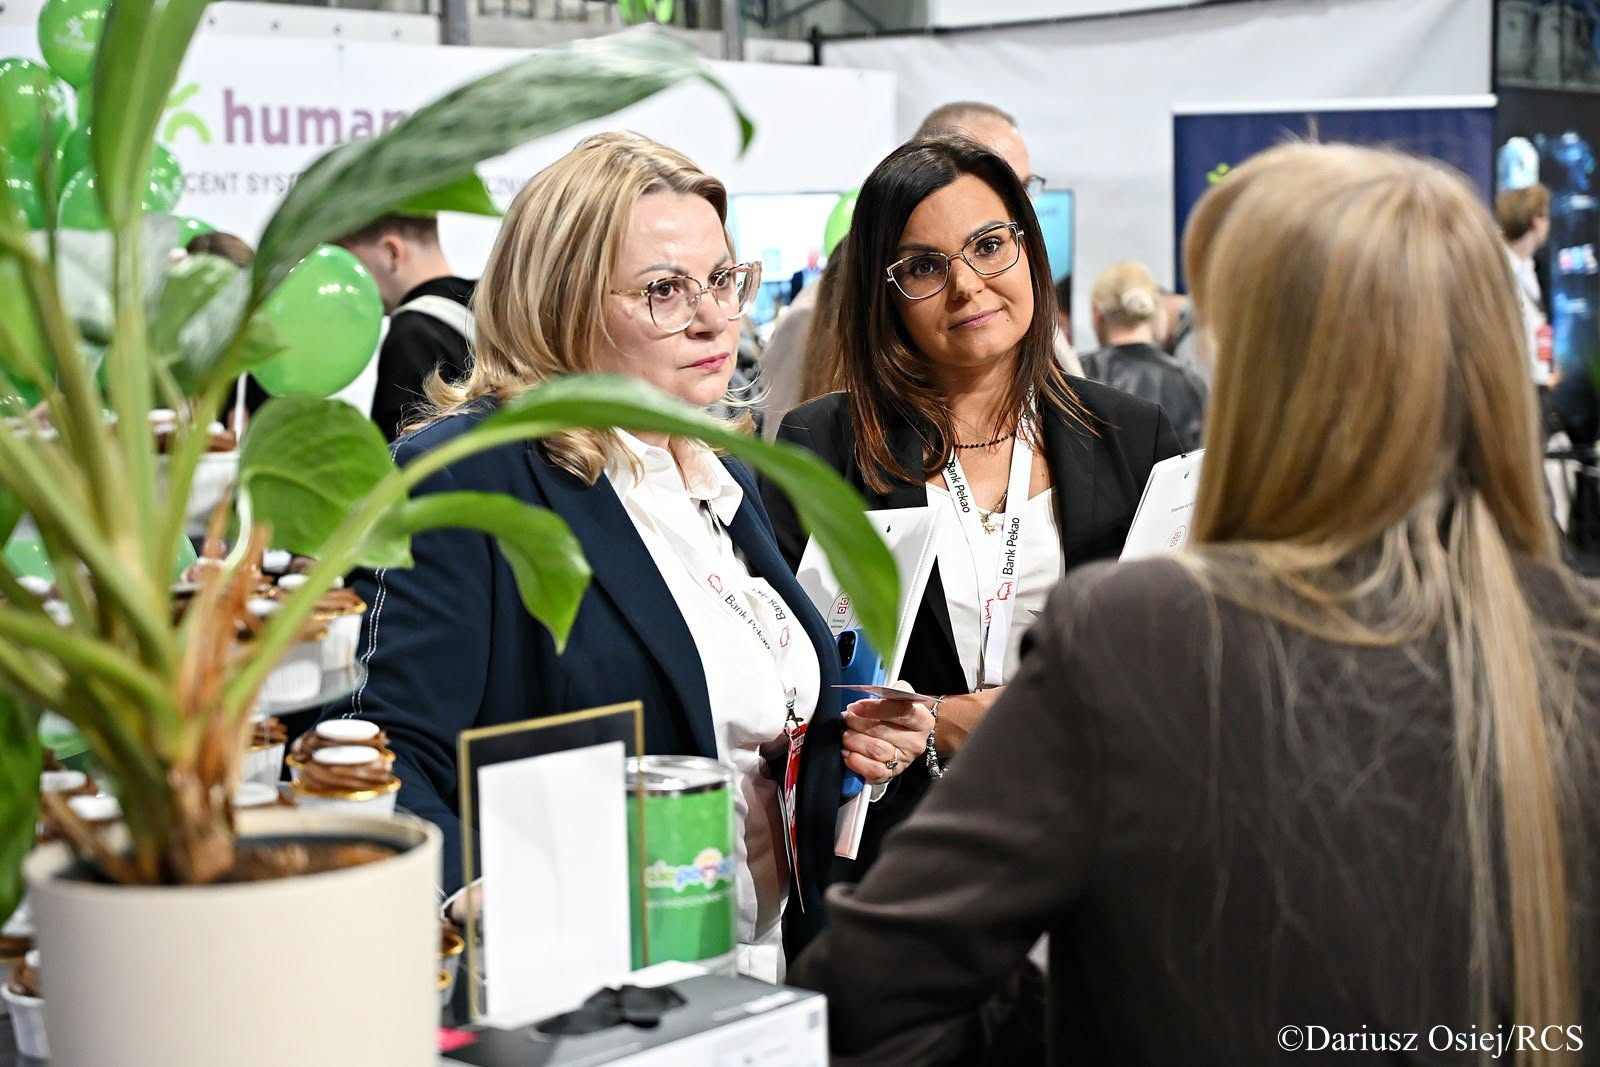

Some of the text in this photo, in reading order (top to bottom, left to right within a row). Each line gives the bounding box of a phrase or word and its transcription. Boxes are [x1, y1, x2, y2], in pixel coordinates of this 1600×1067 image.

[955, 484, 971, 513] Pekao
[1002, 517, 1021, 576] Bank Pekao
[724, 594, 747, 620] Bank
[747, 619, 771, 650] Pekao
